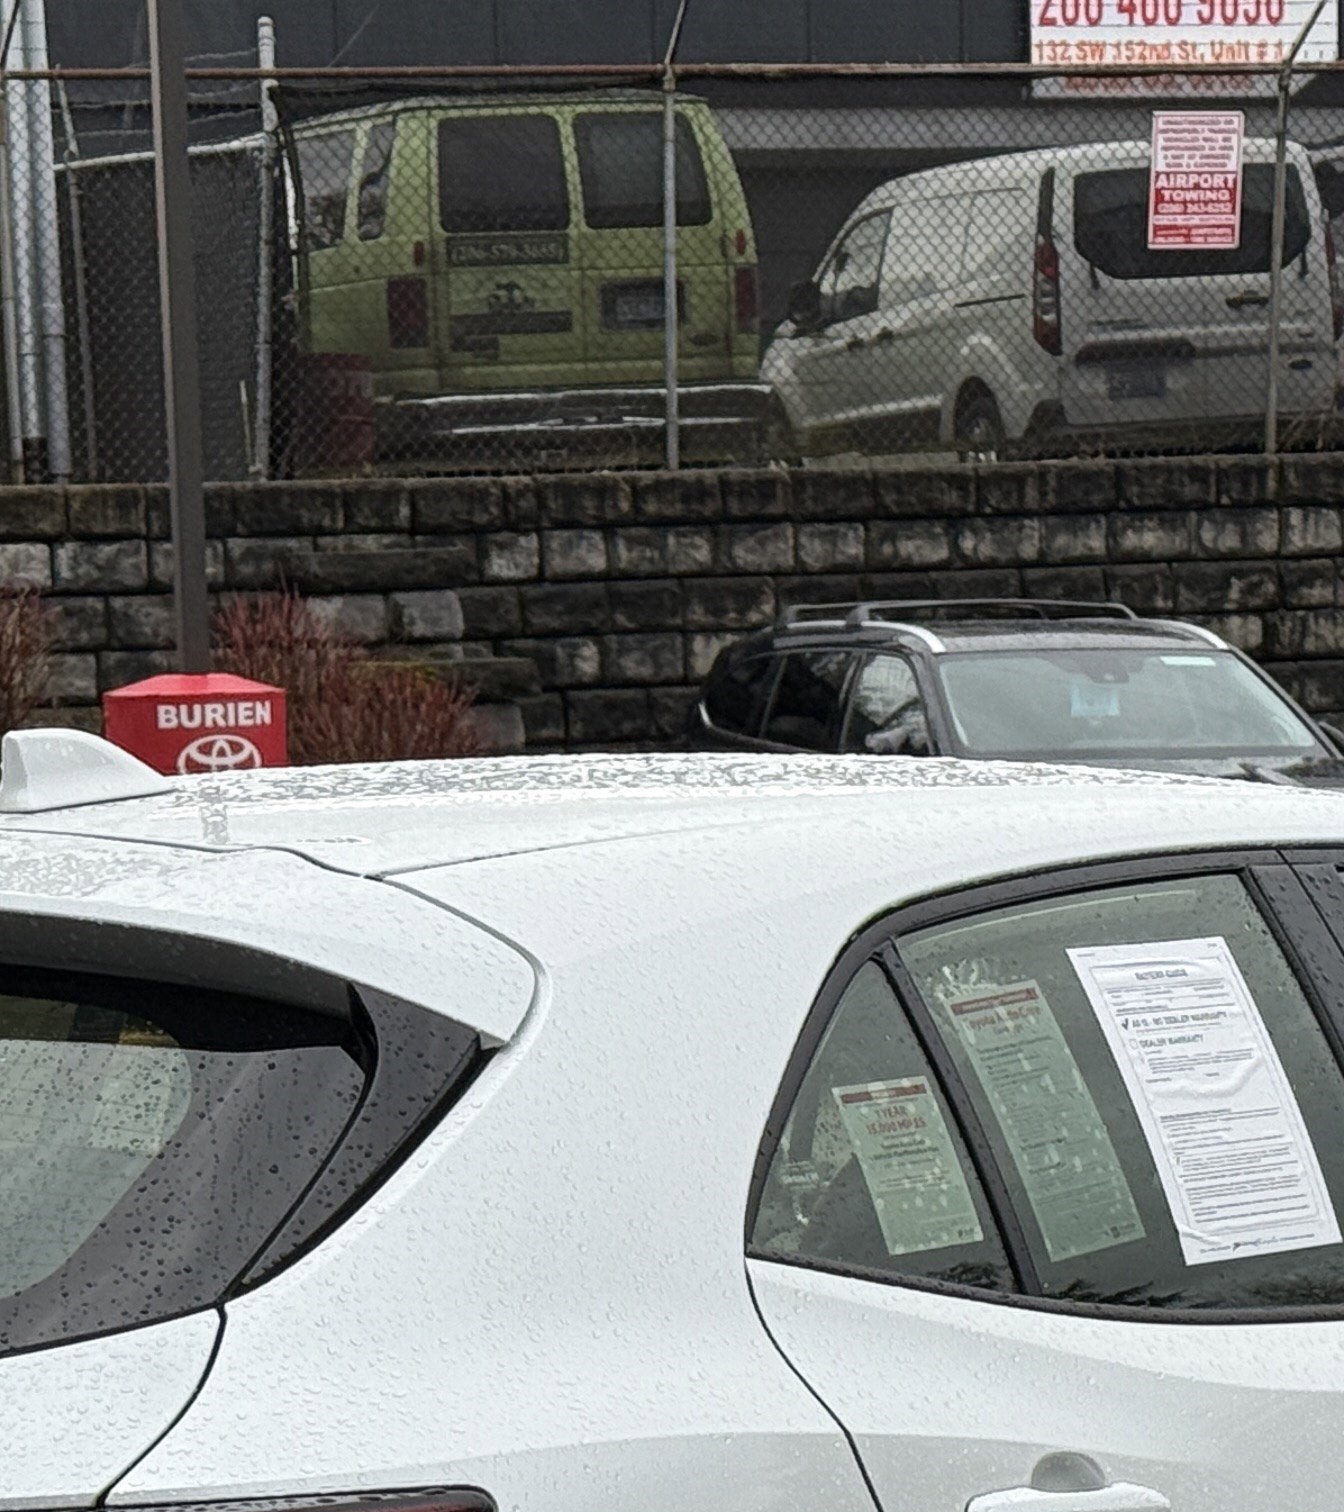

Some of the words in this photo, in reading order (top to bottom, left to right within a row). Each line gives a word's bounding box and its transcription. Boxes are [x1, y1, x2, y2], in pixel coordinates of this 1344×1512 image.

[1035, 39, 1071, 61] 132
[1076, 39, 1105, 61] SW
[1112, 38, 1172, 62] 152nd
[1210, 39, 1251, 61] Unit
[1155, 173, 1237, 189] AIRPORT
[1160, 189, 1231, 202] TOWING
[157, 701, 272, 730] BURIEN
[897, 1116, 927, 1131] MIES
